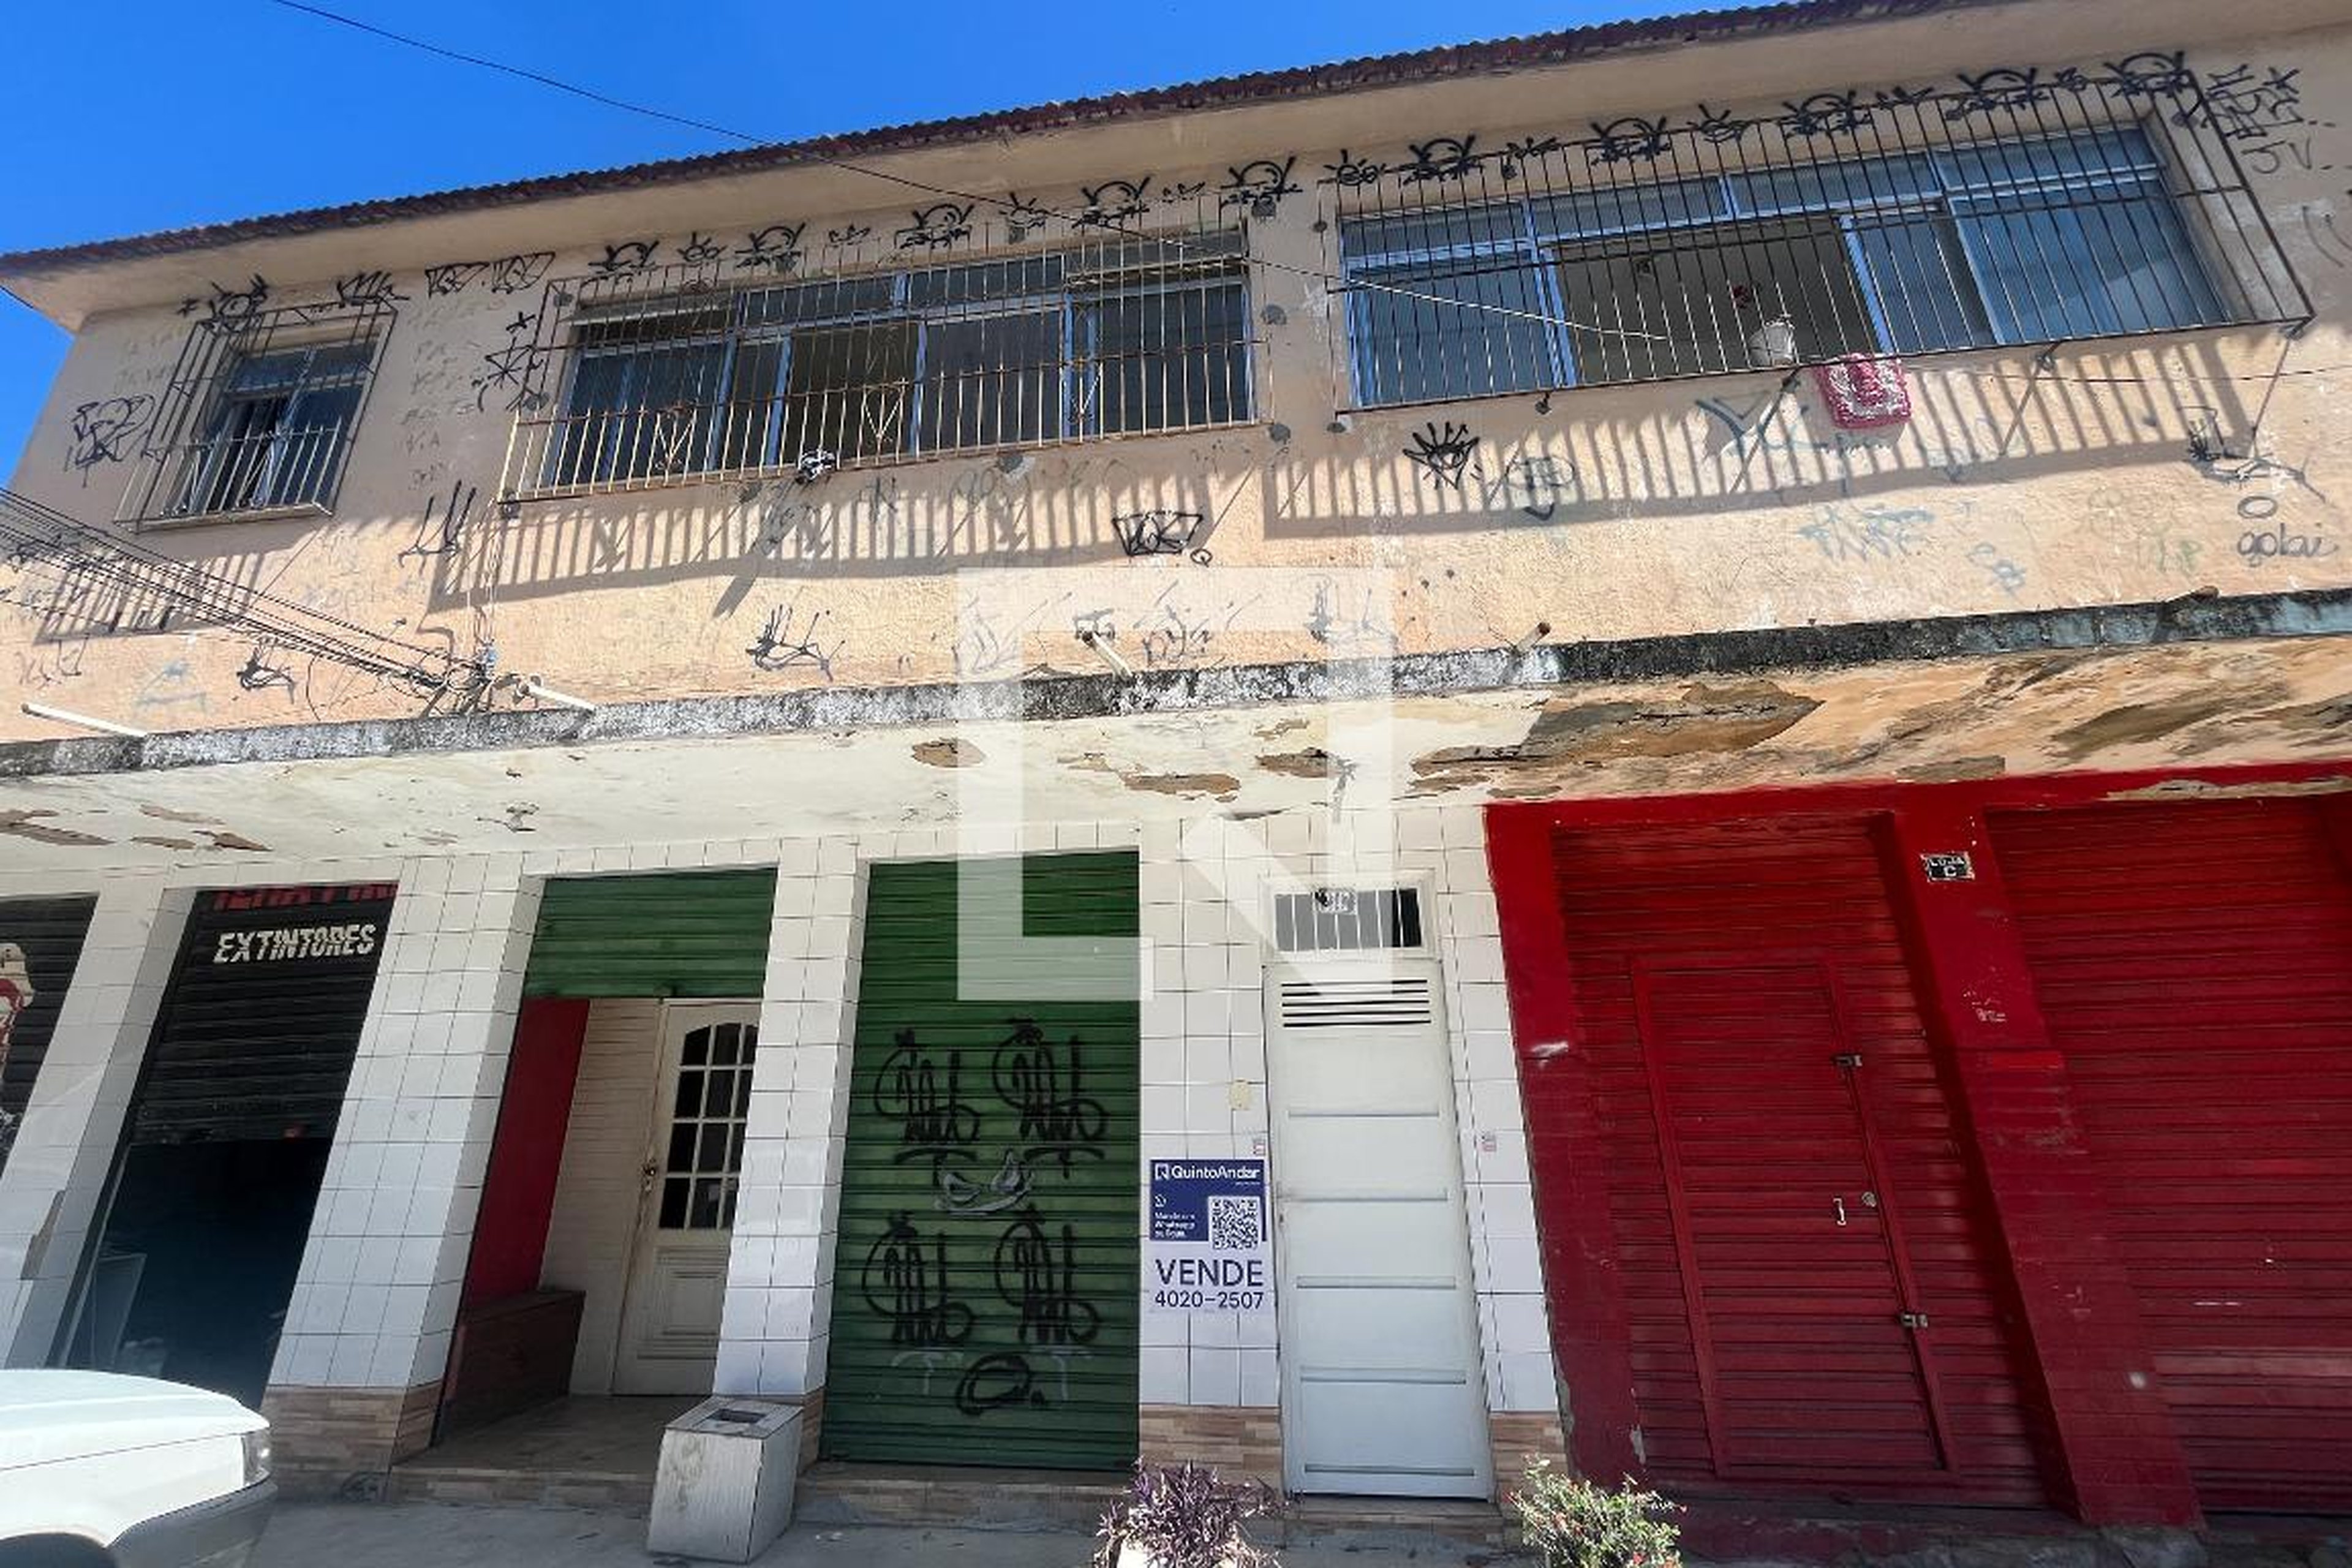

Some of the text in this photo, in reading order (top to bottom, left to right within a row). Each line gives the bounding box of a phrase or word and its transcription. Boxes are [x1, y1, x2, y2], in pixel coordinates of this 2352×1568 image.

[213, 924, 377, 964] EXTINTORES
[1171, 1164, 1261, 1179] QuintoAndar
[1155, 1259, 1264, 1287] VENDE
[1155, 1289, 1264, 1310] 4020-2507
